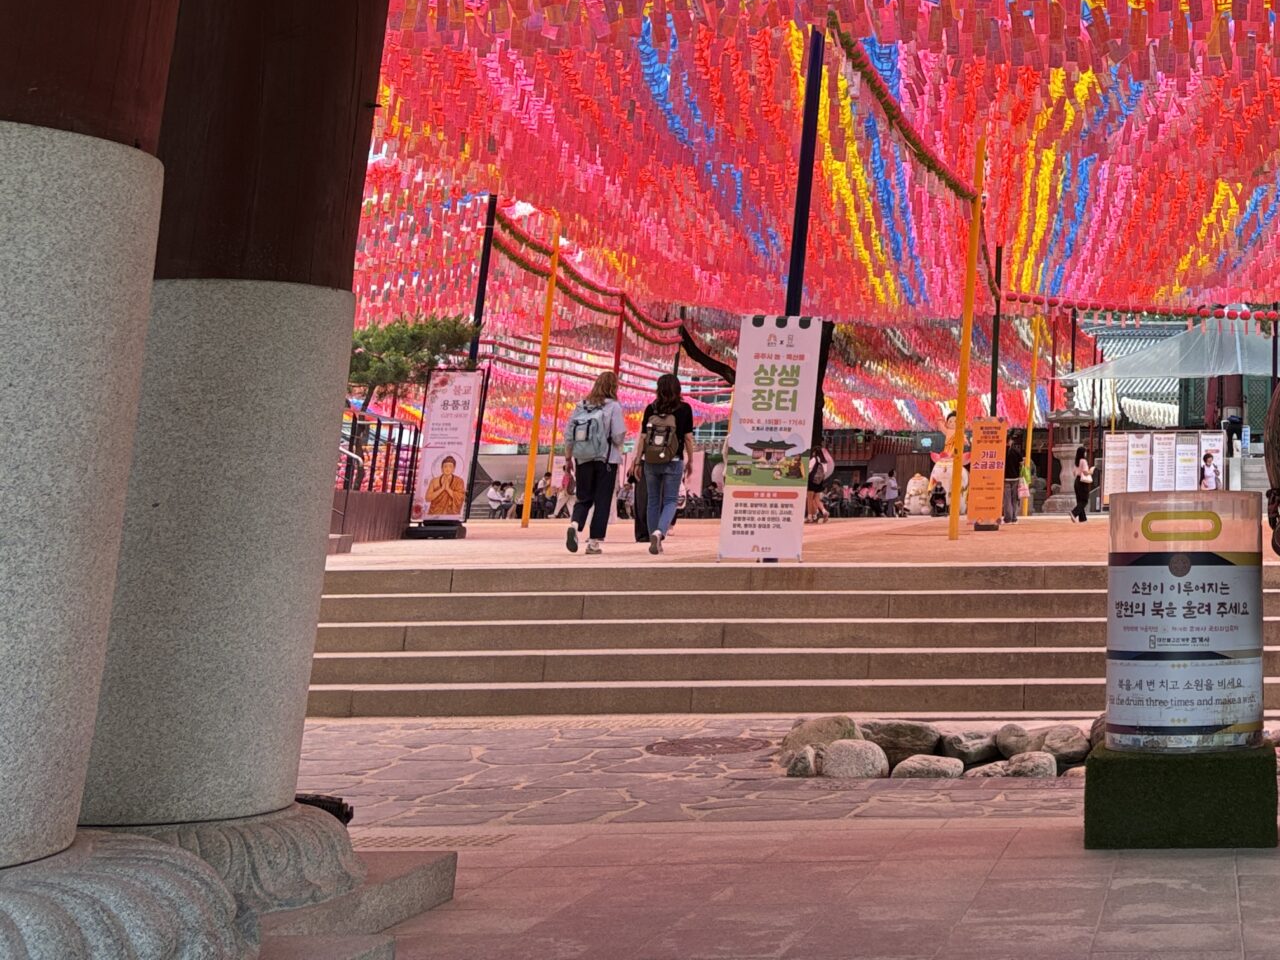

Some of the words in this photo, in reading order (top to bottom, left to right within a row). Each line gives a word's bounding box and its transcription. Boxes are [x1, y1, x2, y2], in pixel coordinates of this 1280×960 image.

[753, 364, 801, 387] 상생
[441, 400, 470, 410] 용품점
[751, 389, 798, 412] 장터
[1131, 581, 1163, 595] 소원이
[1169, 581, 1230, 595] 이루어지는
[1114, 600, 1146, 618] 발원의
[1151, 600, 1177, 618] 북을
[1182, 600, 1211, 619] 울려
[1216, 601, 1250, 618] 주세요
[1118, 679, 1132, 691] 북을
[1134, 679, 1143, 691] 세
[1146, 679, 1155, 691] 번
[1159, 679, 1180, 691] 치고
[1182, 678, 1214, 691] 소원을
[1217, 677, 1243, 690] 비세요
[1124, 697, 1144, 706] drum
[1145, 697, 1169, 707] three
[1171, 696, 1194, 707] times
[1197, 696, 1213, 706] and
[1214, 695, 1235, 706] make
